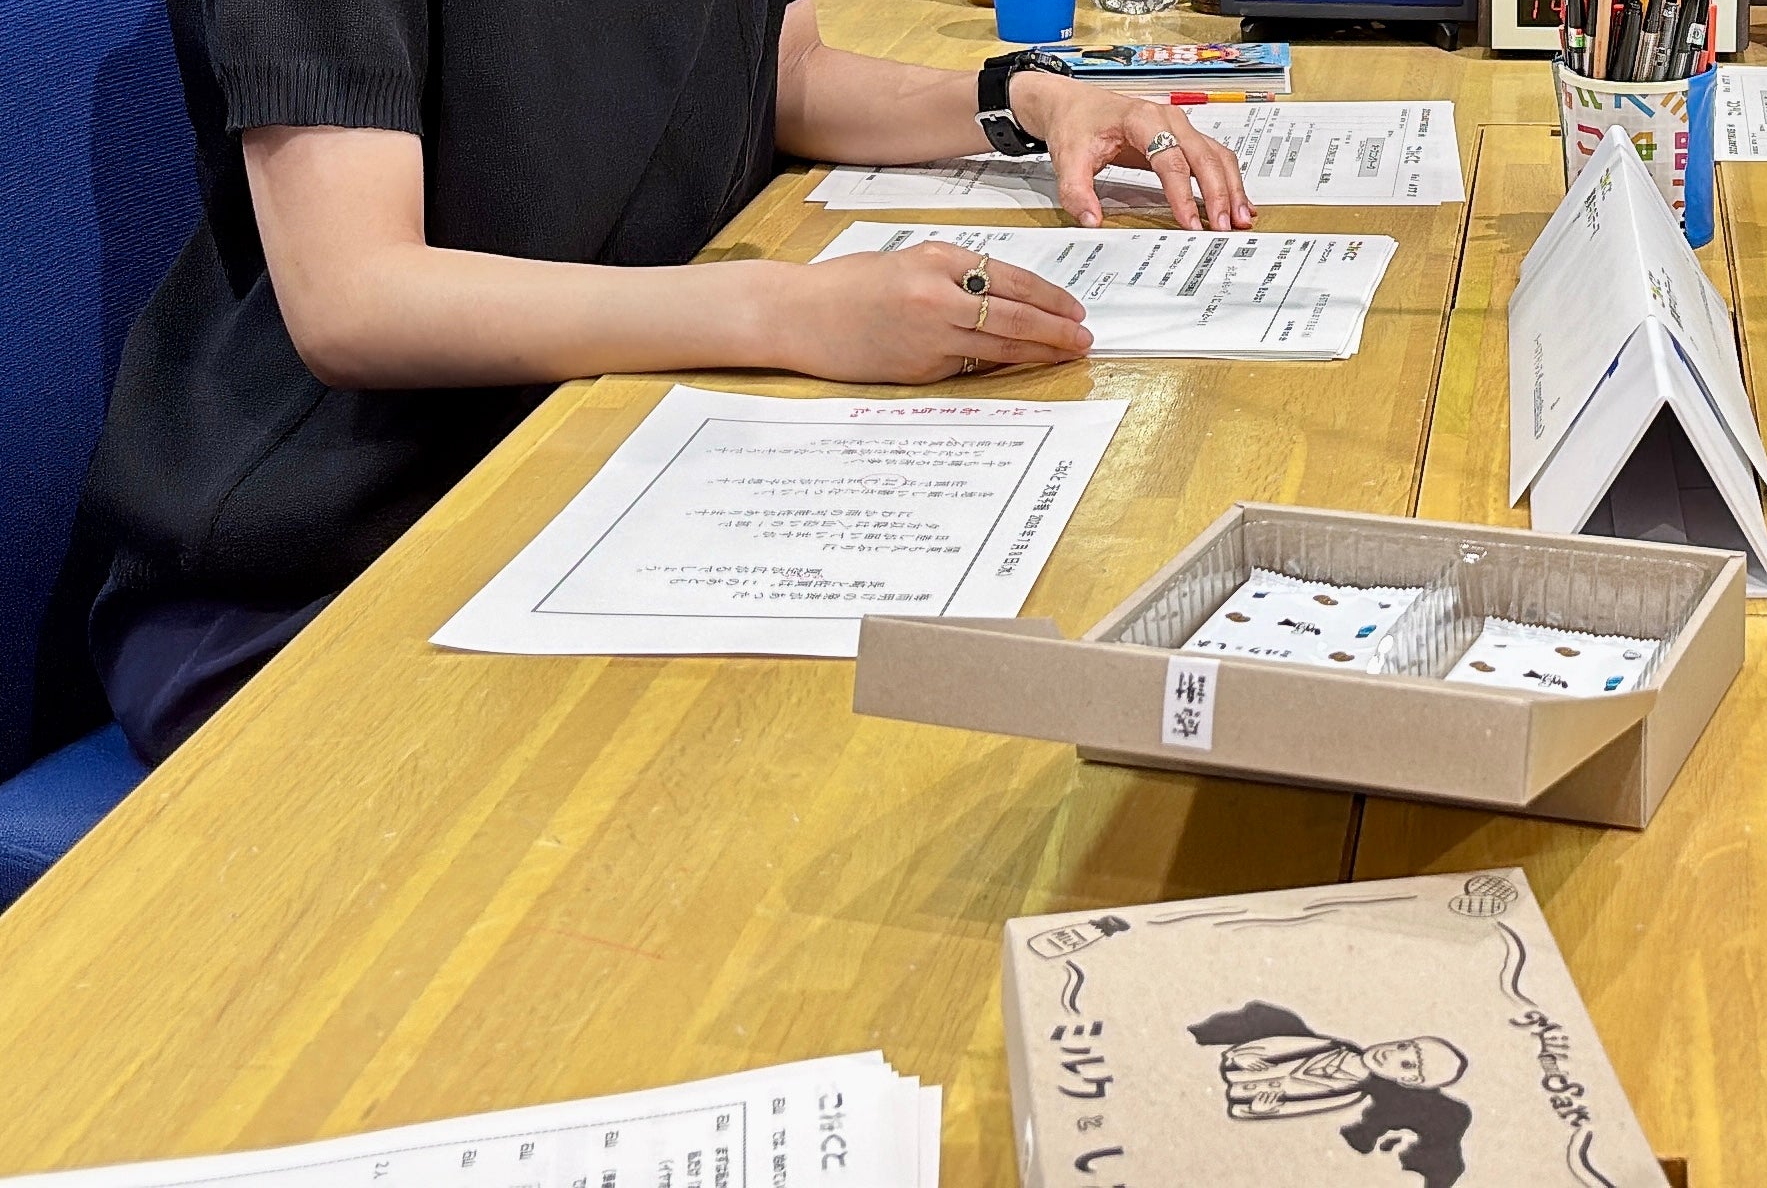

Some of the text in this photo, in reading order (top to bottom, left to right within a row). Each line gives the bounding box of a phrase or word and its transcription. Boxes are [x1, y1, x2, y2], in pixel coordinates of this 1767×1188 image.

[1052, 930, 1082, 950] MILK
[1050, 1020, 1126, 1188] ミルクとし
